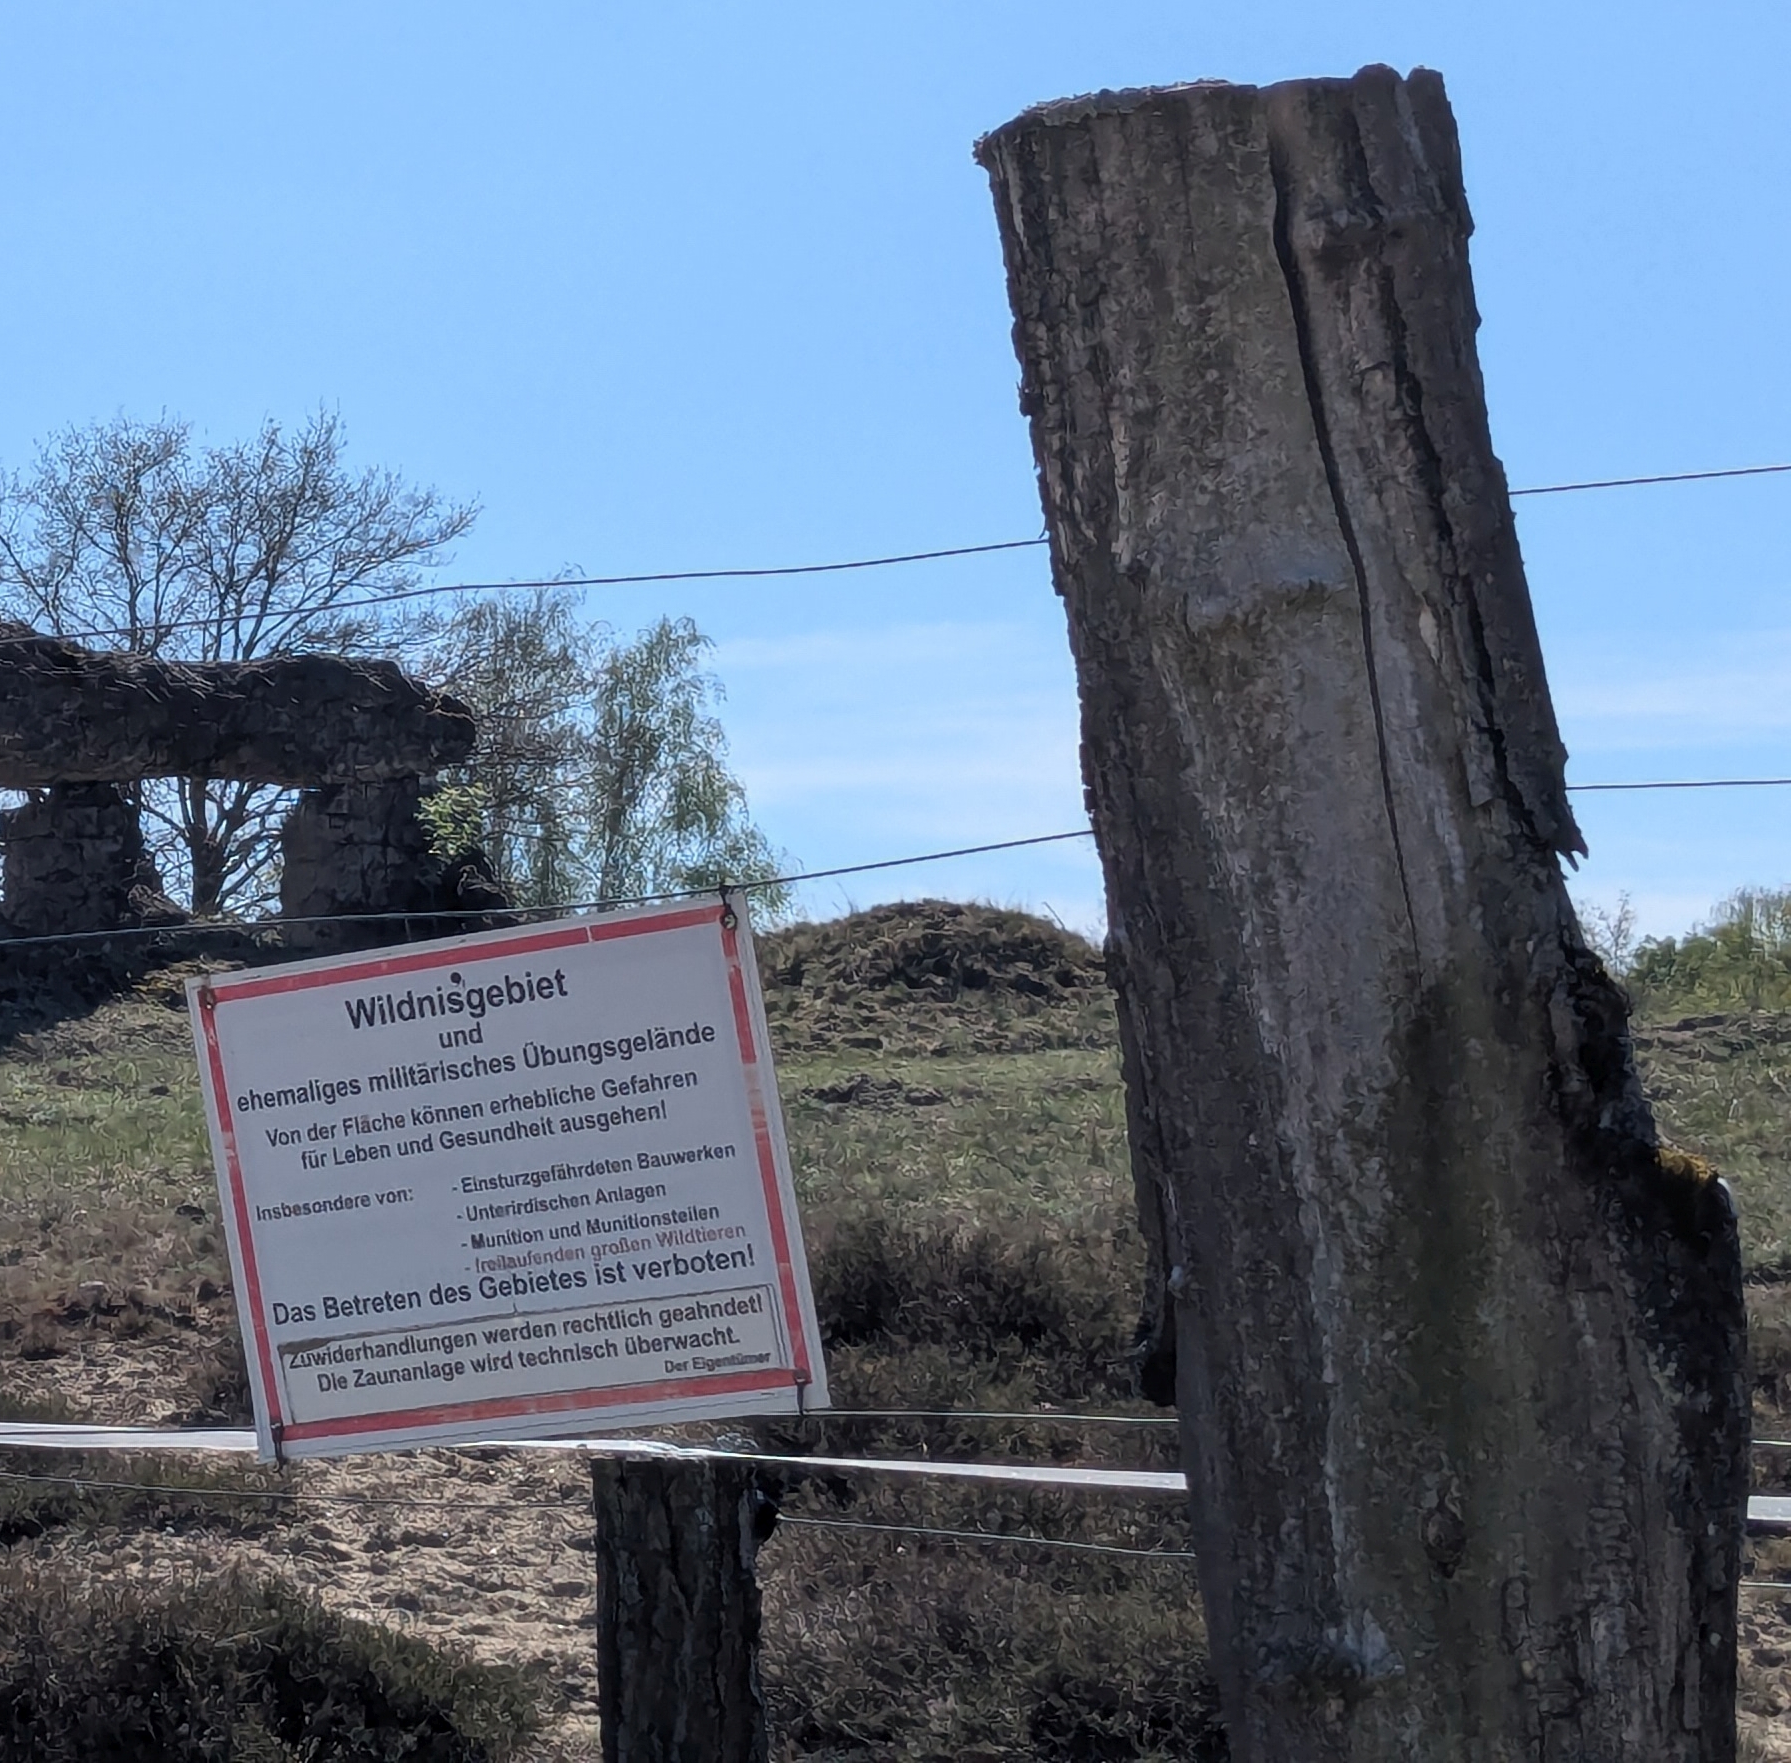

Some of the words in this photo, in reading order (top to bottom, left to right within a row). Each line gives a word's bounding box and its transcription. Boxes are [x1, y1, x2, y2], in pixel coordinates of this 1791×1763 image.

[344, 968, 569, 1030] Wildnisgebiet
[438, 1021, 484, 1049] und
[237, 1078, 362, 1113] ehemaliges
[367, 1054, 516, 1093] militärisches
[522, 1021, 716, 1069] Übungsgelände
[264, 1127, 302, 1148] Von
[306, 1122, 338, 1142] der
[342, 1112, 406, 1137] Fläche
[410, 1102, 485, 1127] können
[489, 1084, 596, 1116] erhebliche
[601, 1071, 698, 1098] Gefahren
[300, 1149, 328, 1170] für
[332, 1143, 392, 1166] Leben
[396, 1132, 435, 1157] und
[438, 1116, 556, 1150] Gesundheit
[559, 1098, 667, 1134] ausgehen!
[460, 1158, 633, 1194] Einsturzgefährdeten
[636, 1144, 736, 1170] Bauwerken
[255, 1194, 372, 1222] Insbesondere
[374, 1188, 414, 1206] von:
[465, 1193, 591, 1222] Unterirdischen
[594, 1184, 667, 1206] Anlagen
[470, 1228, 545, 1250] Munition
[548, 1220, 582, 1240] und
[585, 1204, 720, 1236] Munitionsteilen
[475, 1245, 585, 1274] freilaufenden
[590, 1236, 652, 1262] großen
[655, 1225, 746, 1248] Wildtieren
[272, 1302, 317, 1326] Das
[322, 1290, 422, 1320] Betreten
[428, 1282, 472, 1306] des
[478, 1268, 588, 1300] Gebietes
[593, 1261, 628, 1286] ist
[631, 1242, 756, 1281] verboten!
[481, 1320, 557, 1345] werden
[562, 1306, 653, 1336] rechtlich
[658, 1292, 764, 1329] geahndet!
[316, 1372, 348, 1393] Die
[352, 1360, 466, 1388] Zaunanlage
[469, 1350, 514, 1374] wird
[517, 1338, 619, 1369] technisch
[624, 1325, 741, 1356] überwacht.
[664, 1359, 689, 1374] Der
